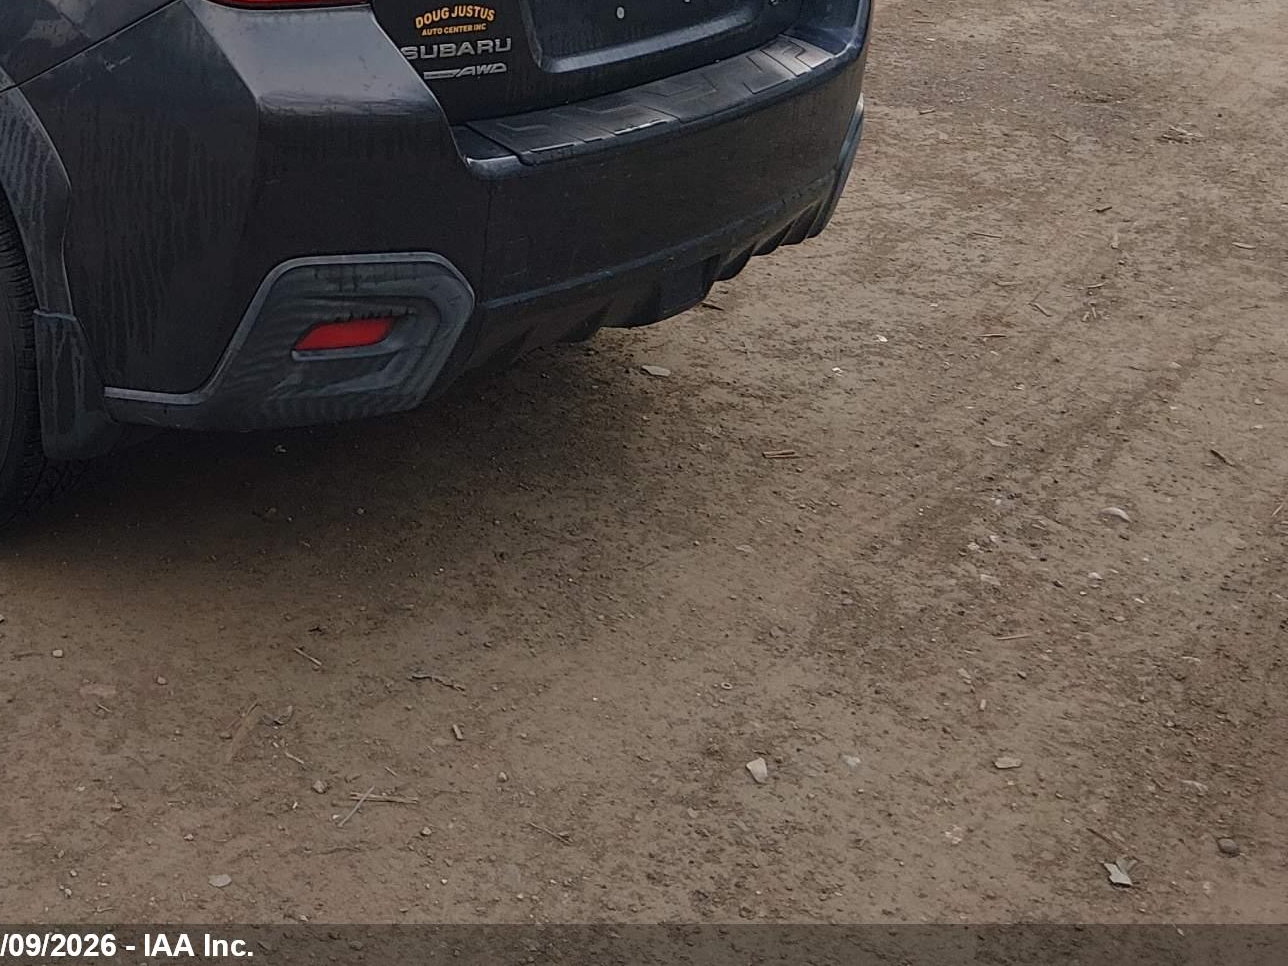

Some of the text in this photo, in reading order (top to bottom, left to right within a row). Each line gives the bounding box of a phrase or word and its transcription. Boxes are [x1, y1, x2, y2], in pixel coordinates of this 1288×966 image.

[415, 4, 496, 29] DOUG JUSTUS
[421, 22, 487, 36] AUTO CENTER INC
[400, 37, 512, 60] SUBARU
[456, 62, 508, 78] AWD
